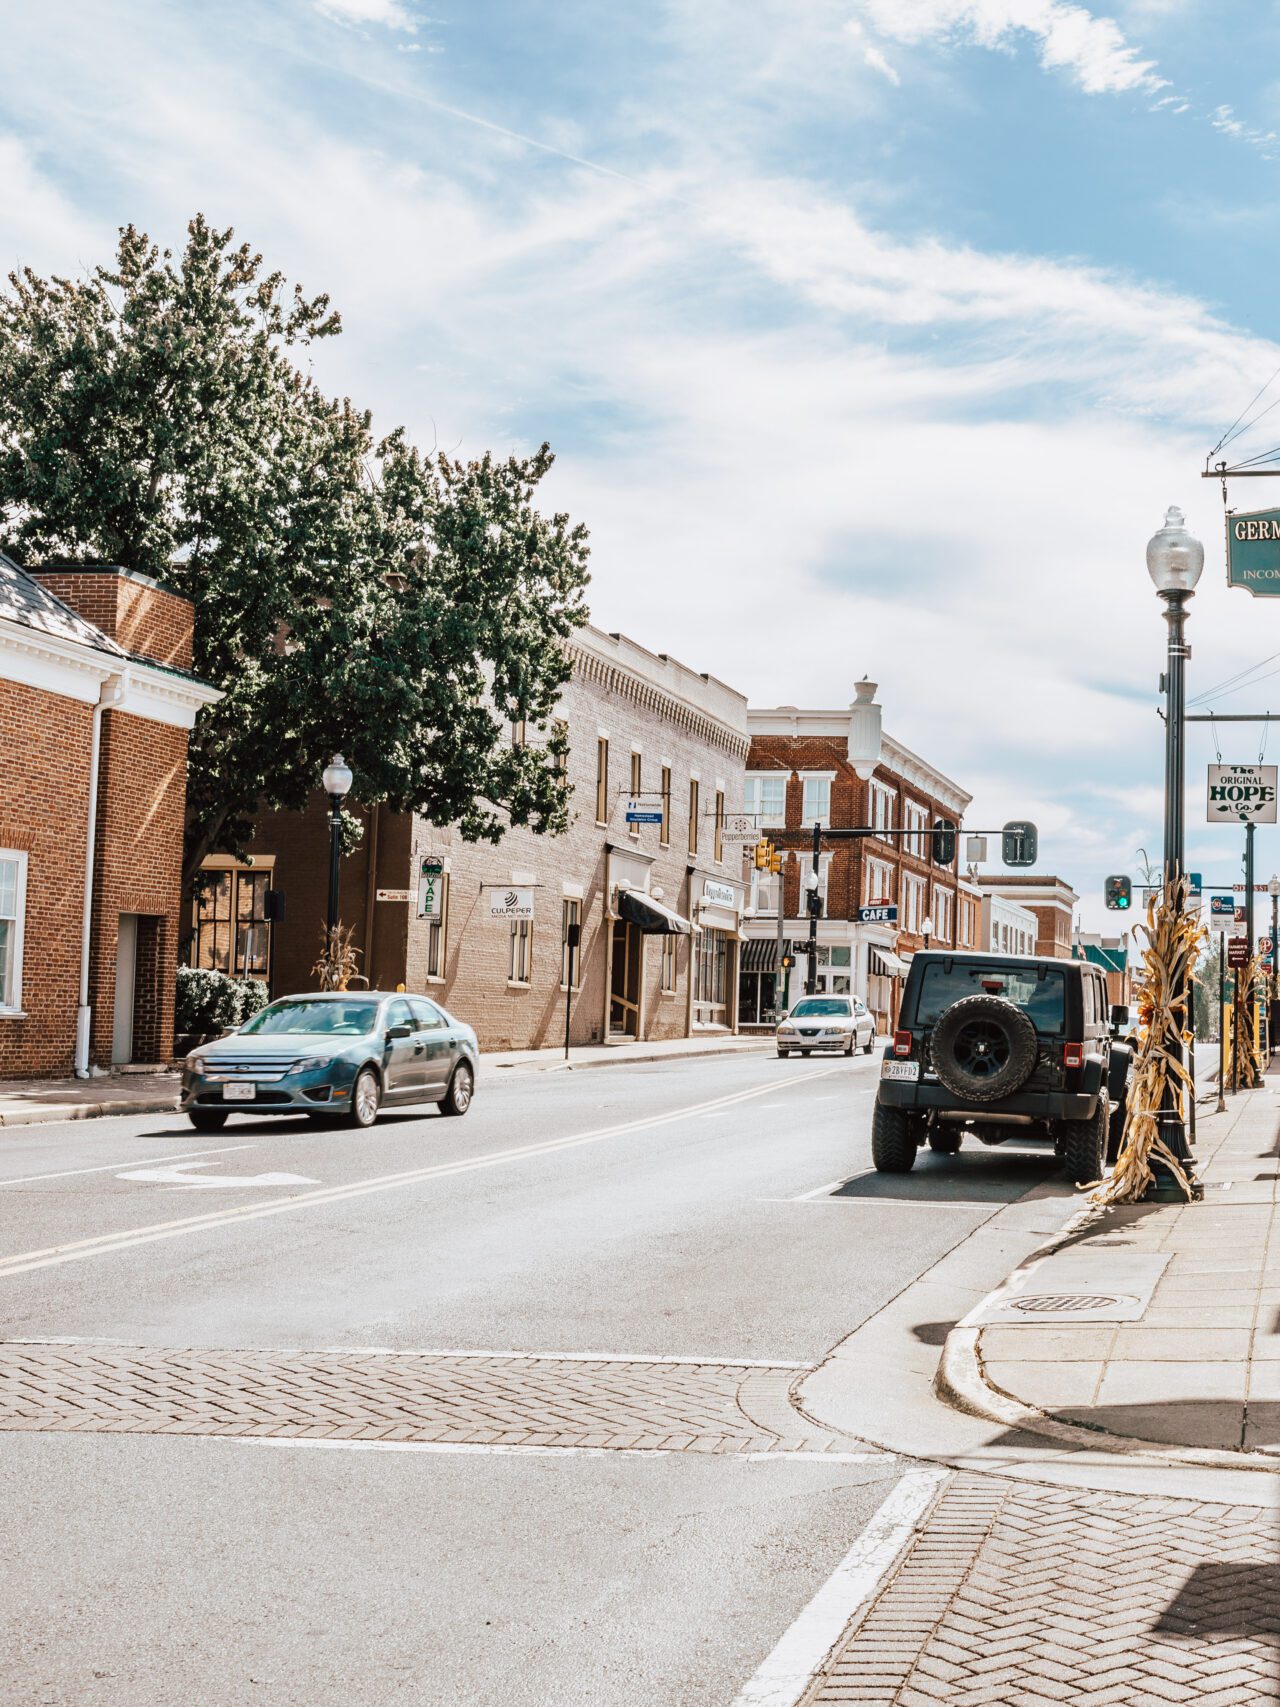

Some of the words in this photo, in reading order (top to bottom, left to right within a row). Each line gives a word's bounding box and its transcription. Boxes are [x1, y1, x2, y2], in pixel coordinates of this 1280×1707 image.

[1230, 766, 1255, 774] The
[1220, 776, 1264, 785] ORIGINAL
[1210, 785, 1275, 801] HOPE
[1235, 802, 1252, 810] Co.
[721, 832, 760, 842] Pepperberries
[424, 878, 435, 913] VAPE
[862, 908, 889, 921] CAFE
